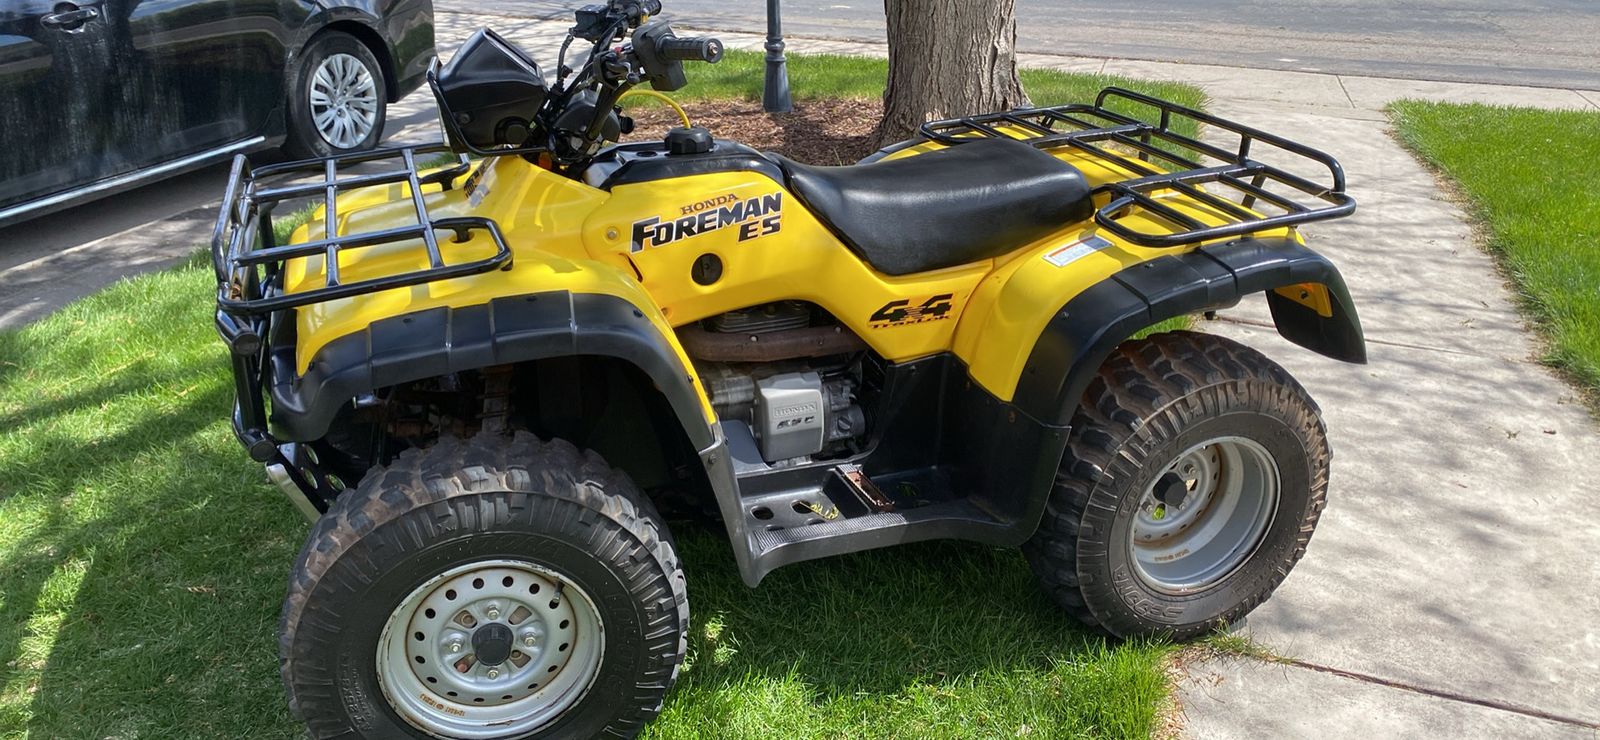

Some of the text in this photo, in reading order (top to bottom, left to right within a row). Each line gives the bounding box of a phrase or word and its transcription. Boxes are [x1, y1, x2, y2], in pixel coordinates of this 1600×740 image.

[680, 193, 739, 215] HONDA
[631, 192, 782, 254] FOREMAN
[737, 214, 782, 243] ES
[775, 402, 816, 417] HONDA
